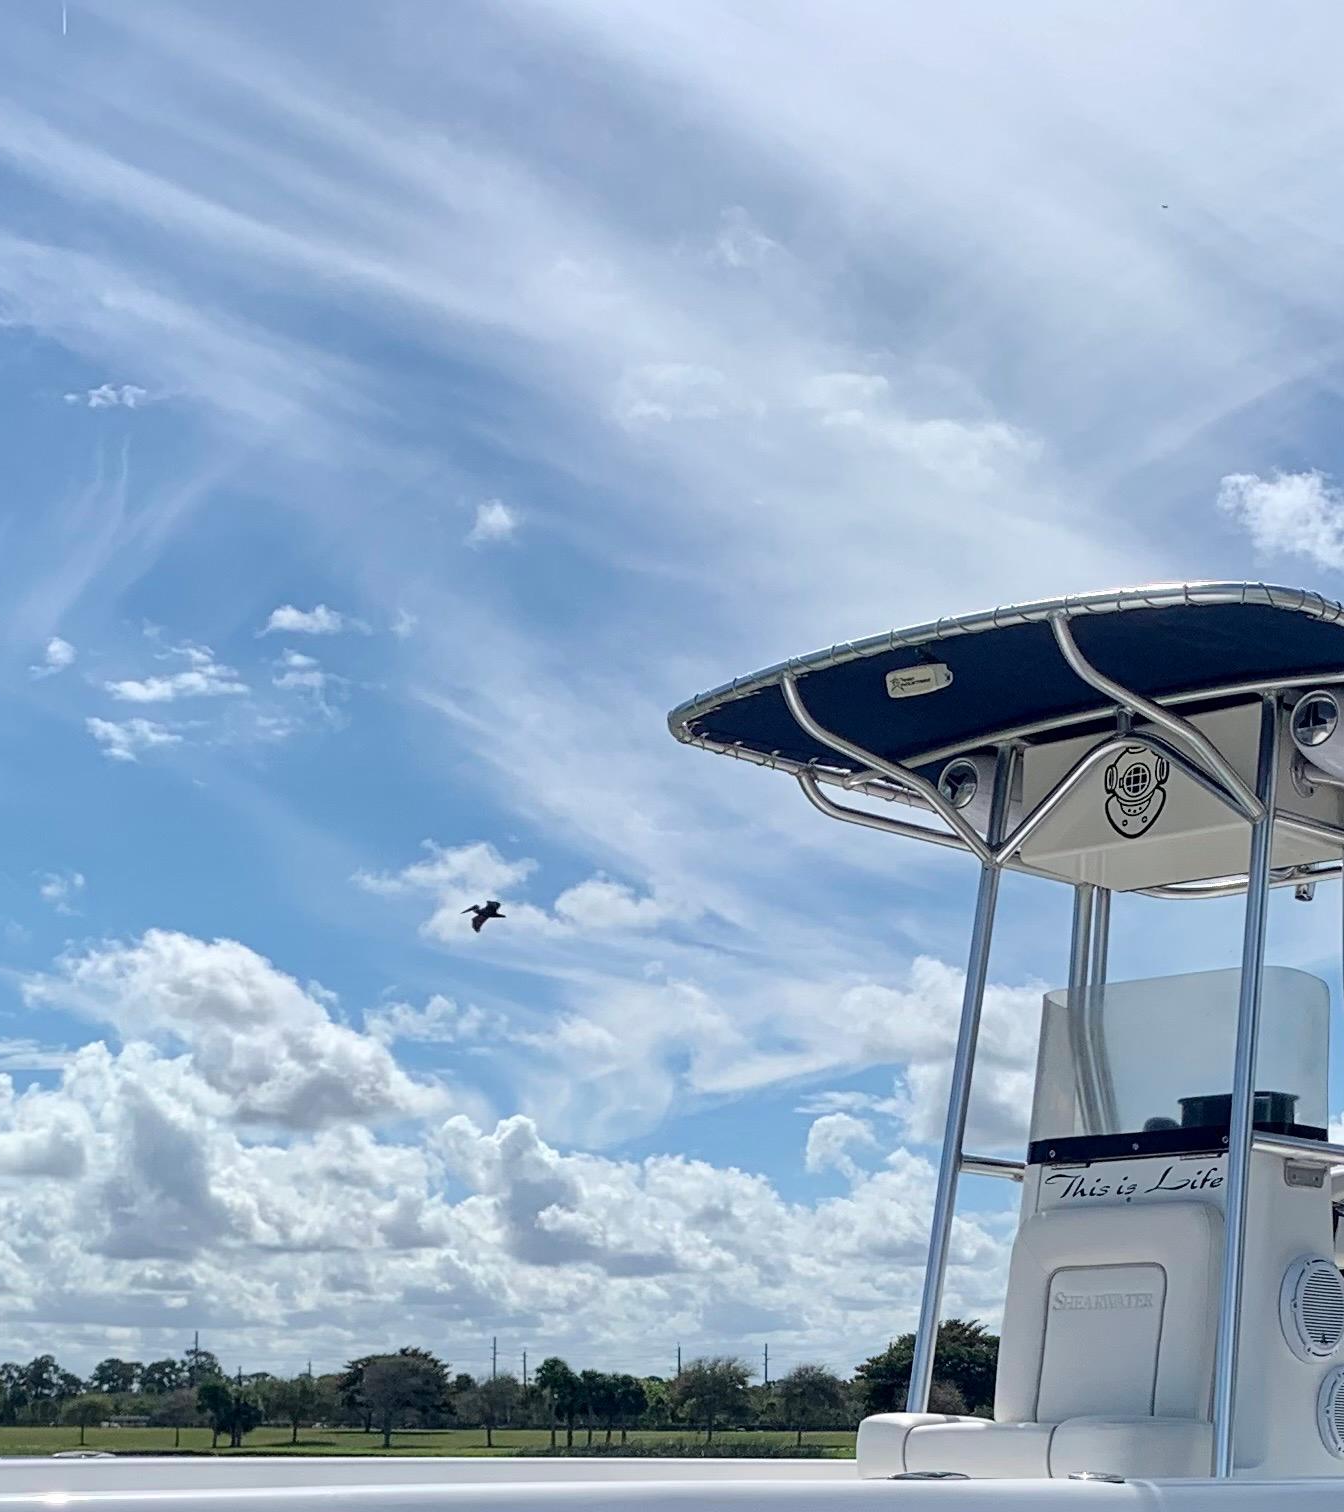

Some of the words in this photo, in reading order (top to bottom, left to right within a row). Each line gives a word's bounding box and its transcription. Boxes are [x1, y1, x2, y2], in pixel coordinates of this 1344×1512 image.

[1045, 1173, 1110, 1198] This
[1116, 1176, 1137, 1195] is
[1144, 1166, 1224, 1194] Life
